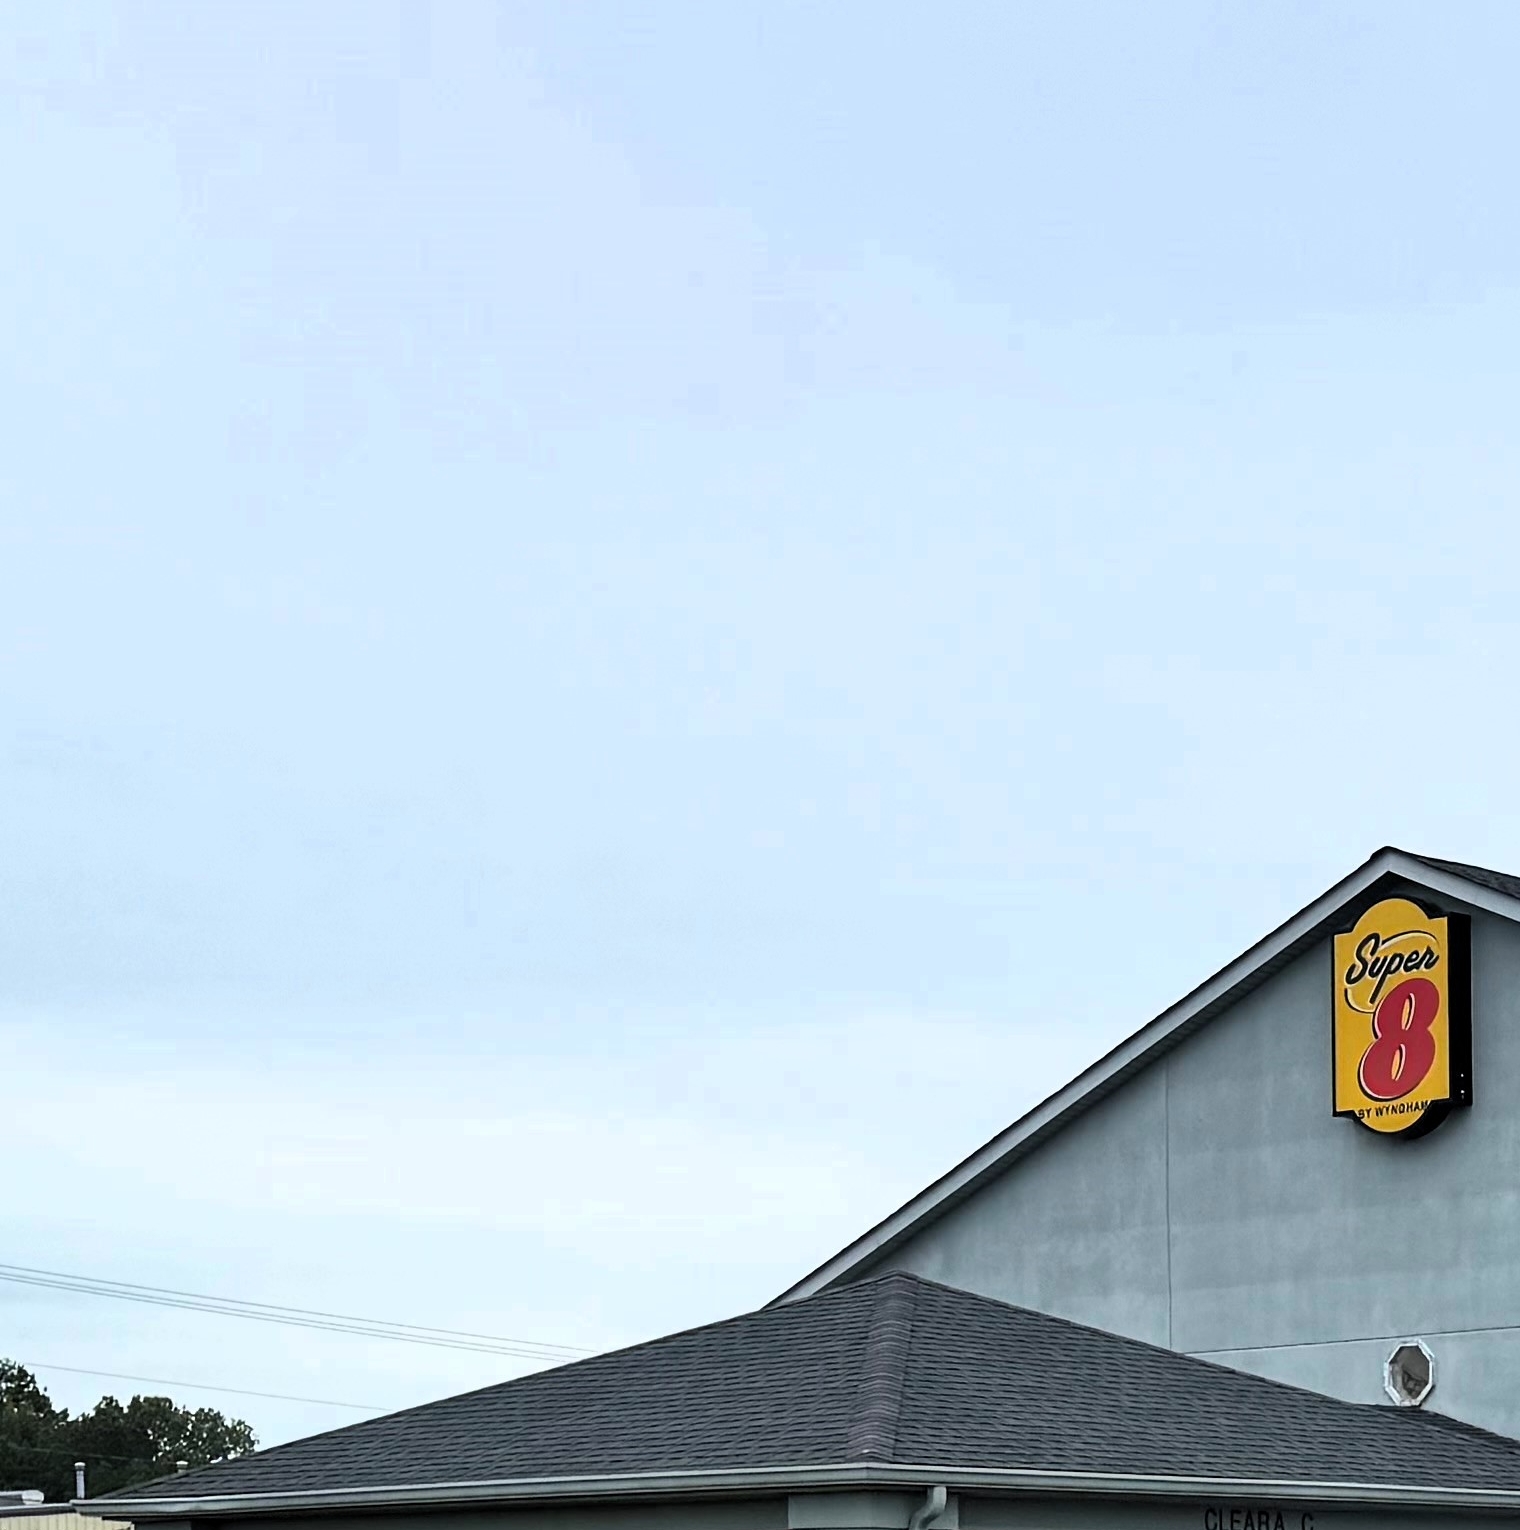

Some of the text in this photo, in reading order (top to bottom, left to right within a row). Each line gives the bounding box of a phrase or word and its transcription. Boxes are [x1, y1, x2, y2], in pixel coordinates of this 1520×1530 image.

[1345, 932, 1440, 1005] Super
[1357, 977, 1441, 1101] 8
[1357, 1100, 1430, 1119] BY WYNDHAM
